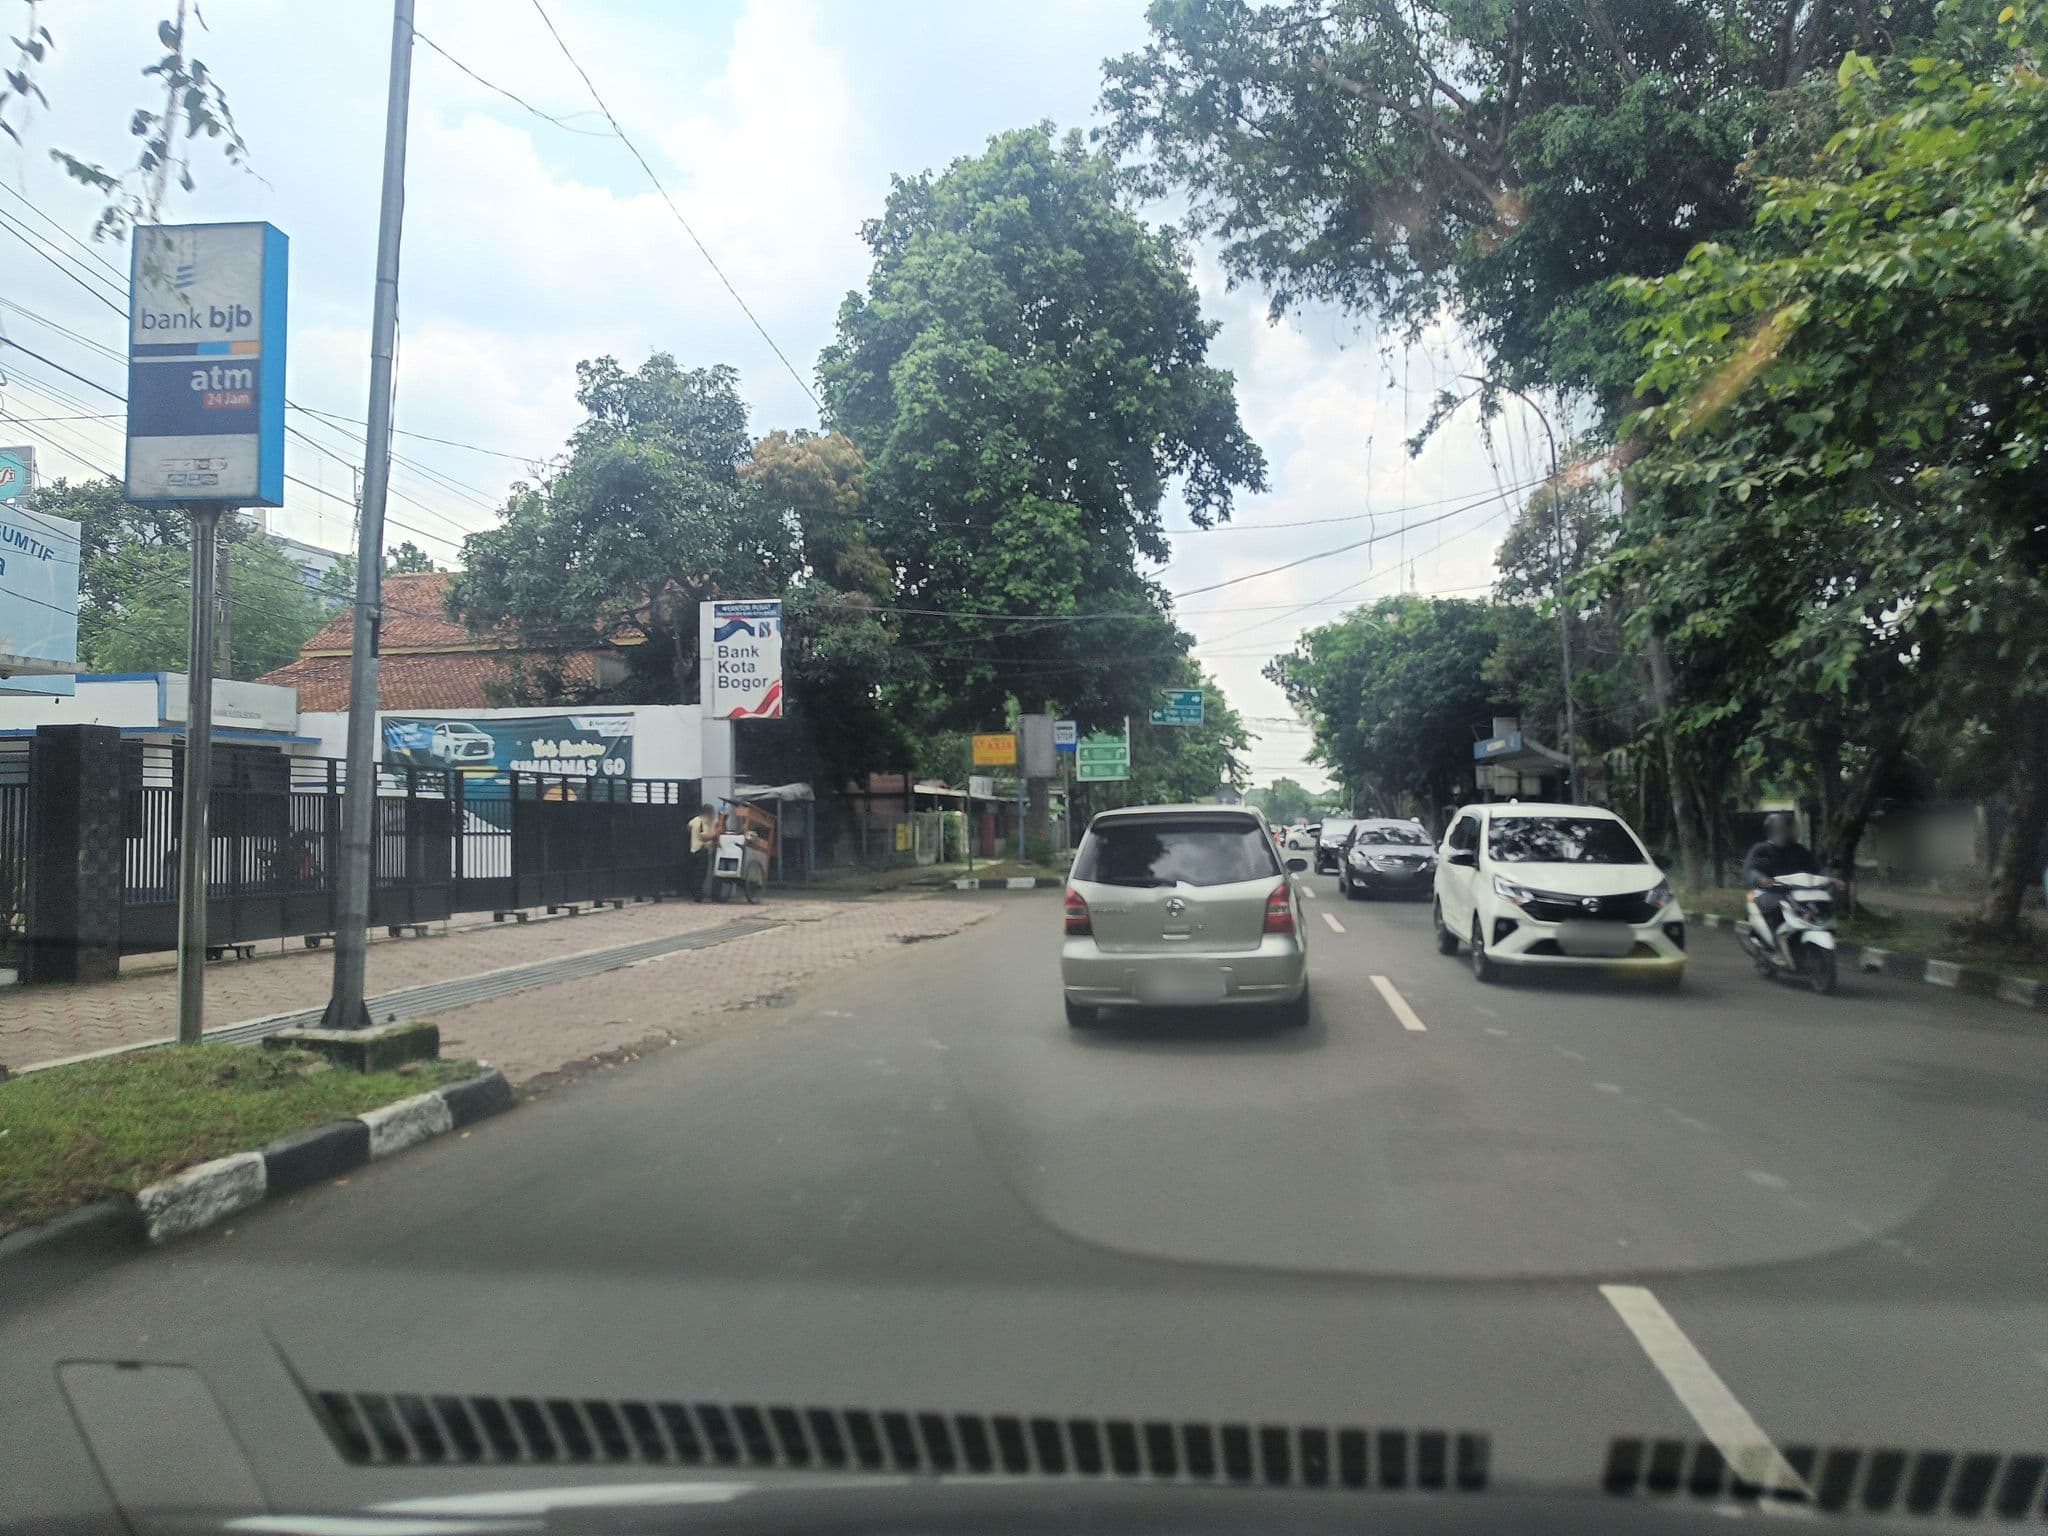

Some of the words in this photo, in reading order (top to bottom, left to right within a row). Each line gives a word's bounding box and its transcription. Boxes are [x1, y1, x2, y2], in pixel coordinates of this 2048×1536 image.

[141, 306, 202, 330] bank
[209, 304, 253, 333] bjb
[190, 365, 253, 391] atm
[0, 524, 55, 562] UMTIF
[718, 645, 760, 659] Bank
[718, 660, 756, 674] Kota
[718, 675, 769, 692] Bogor
[602, 757, 626, 776] GO
